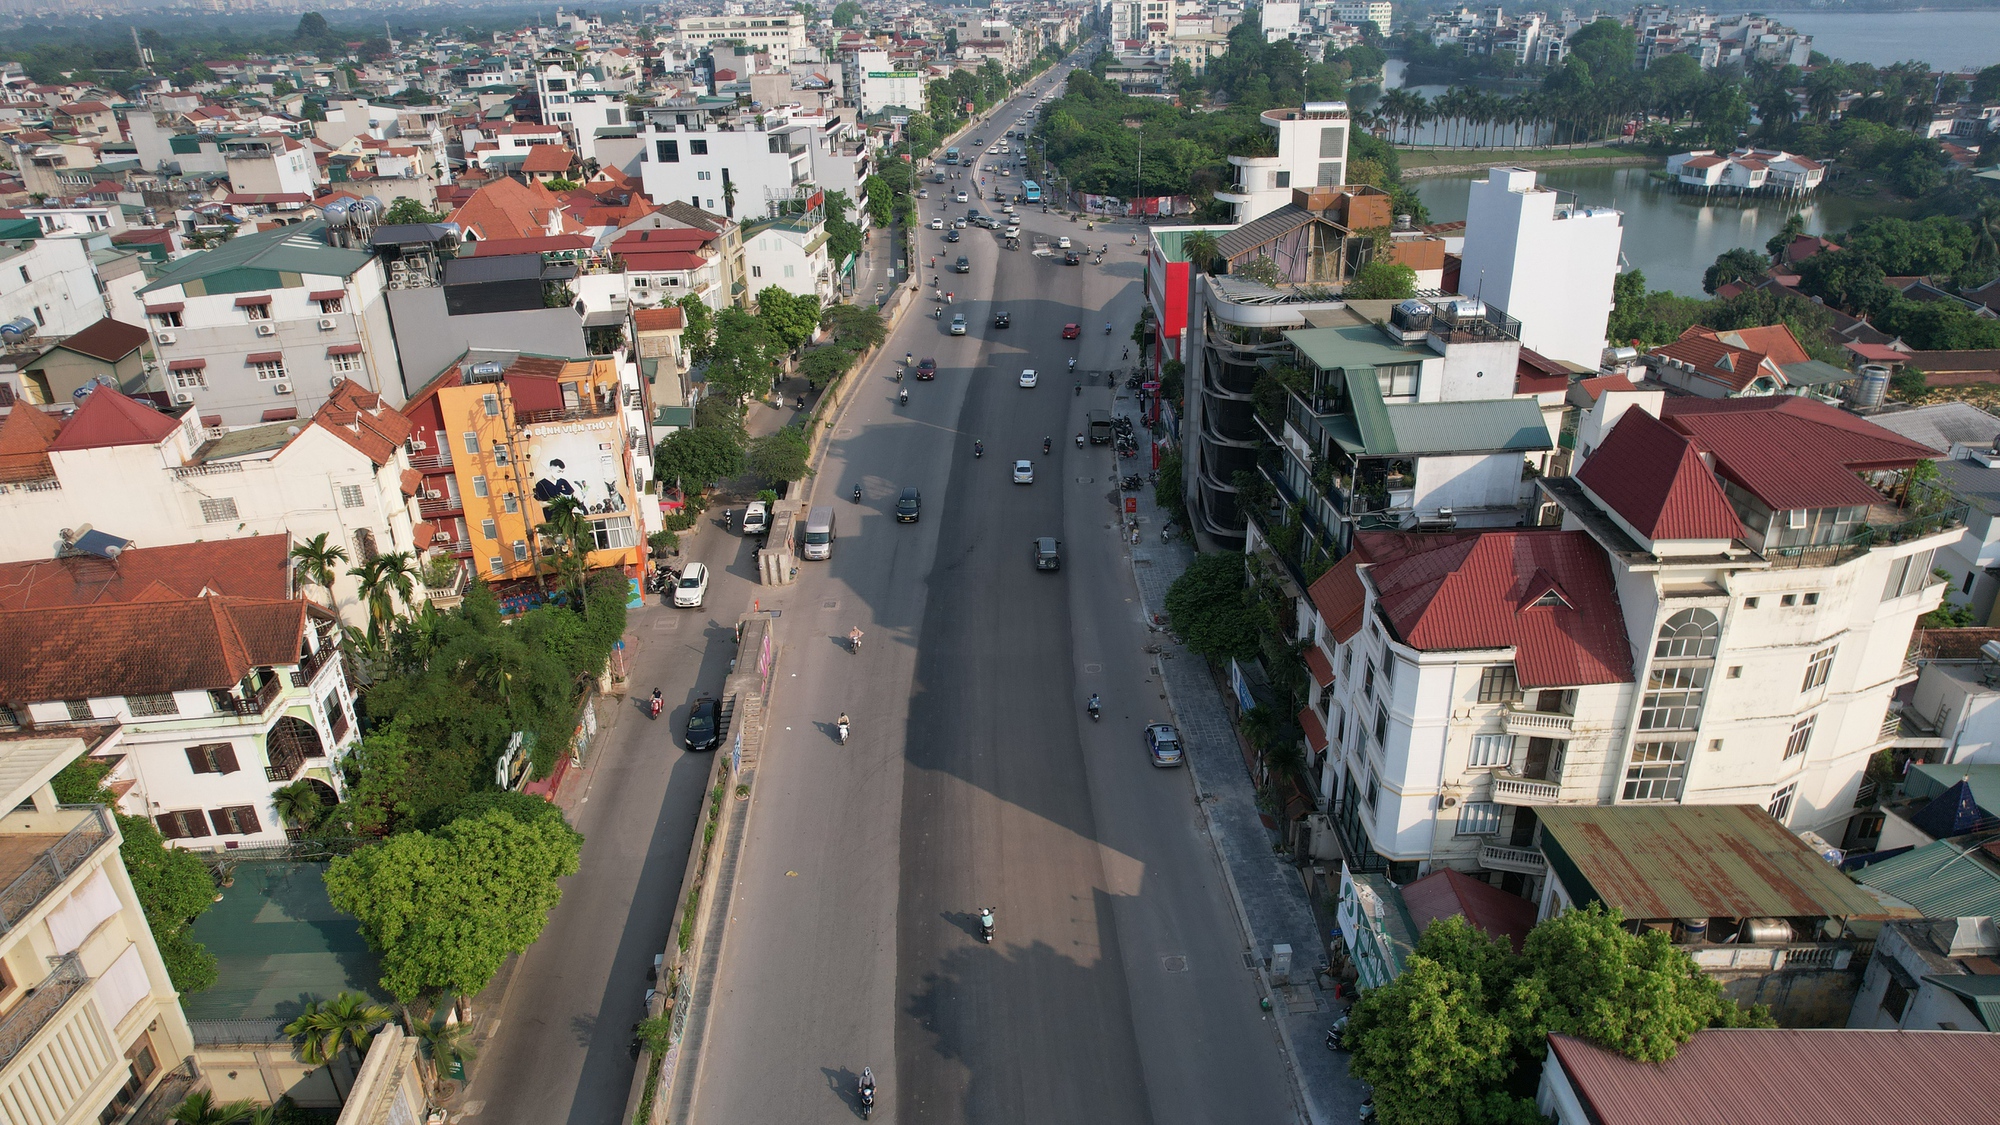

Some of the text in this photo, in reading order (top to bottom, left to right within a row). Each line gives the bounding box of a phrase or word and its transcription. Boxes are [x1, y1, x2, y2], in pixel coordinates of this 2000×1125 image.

[534, 420, 614, 438] BỆNH VIỆN THÚ Y
